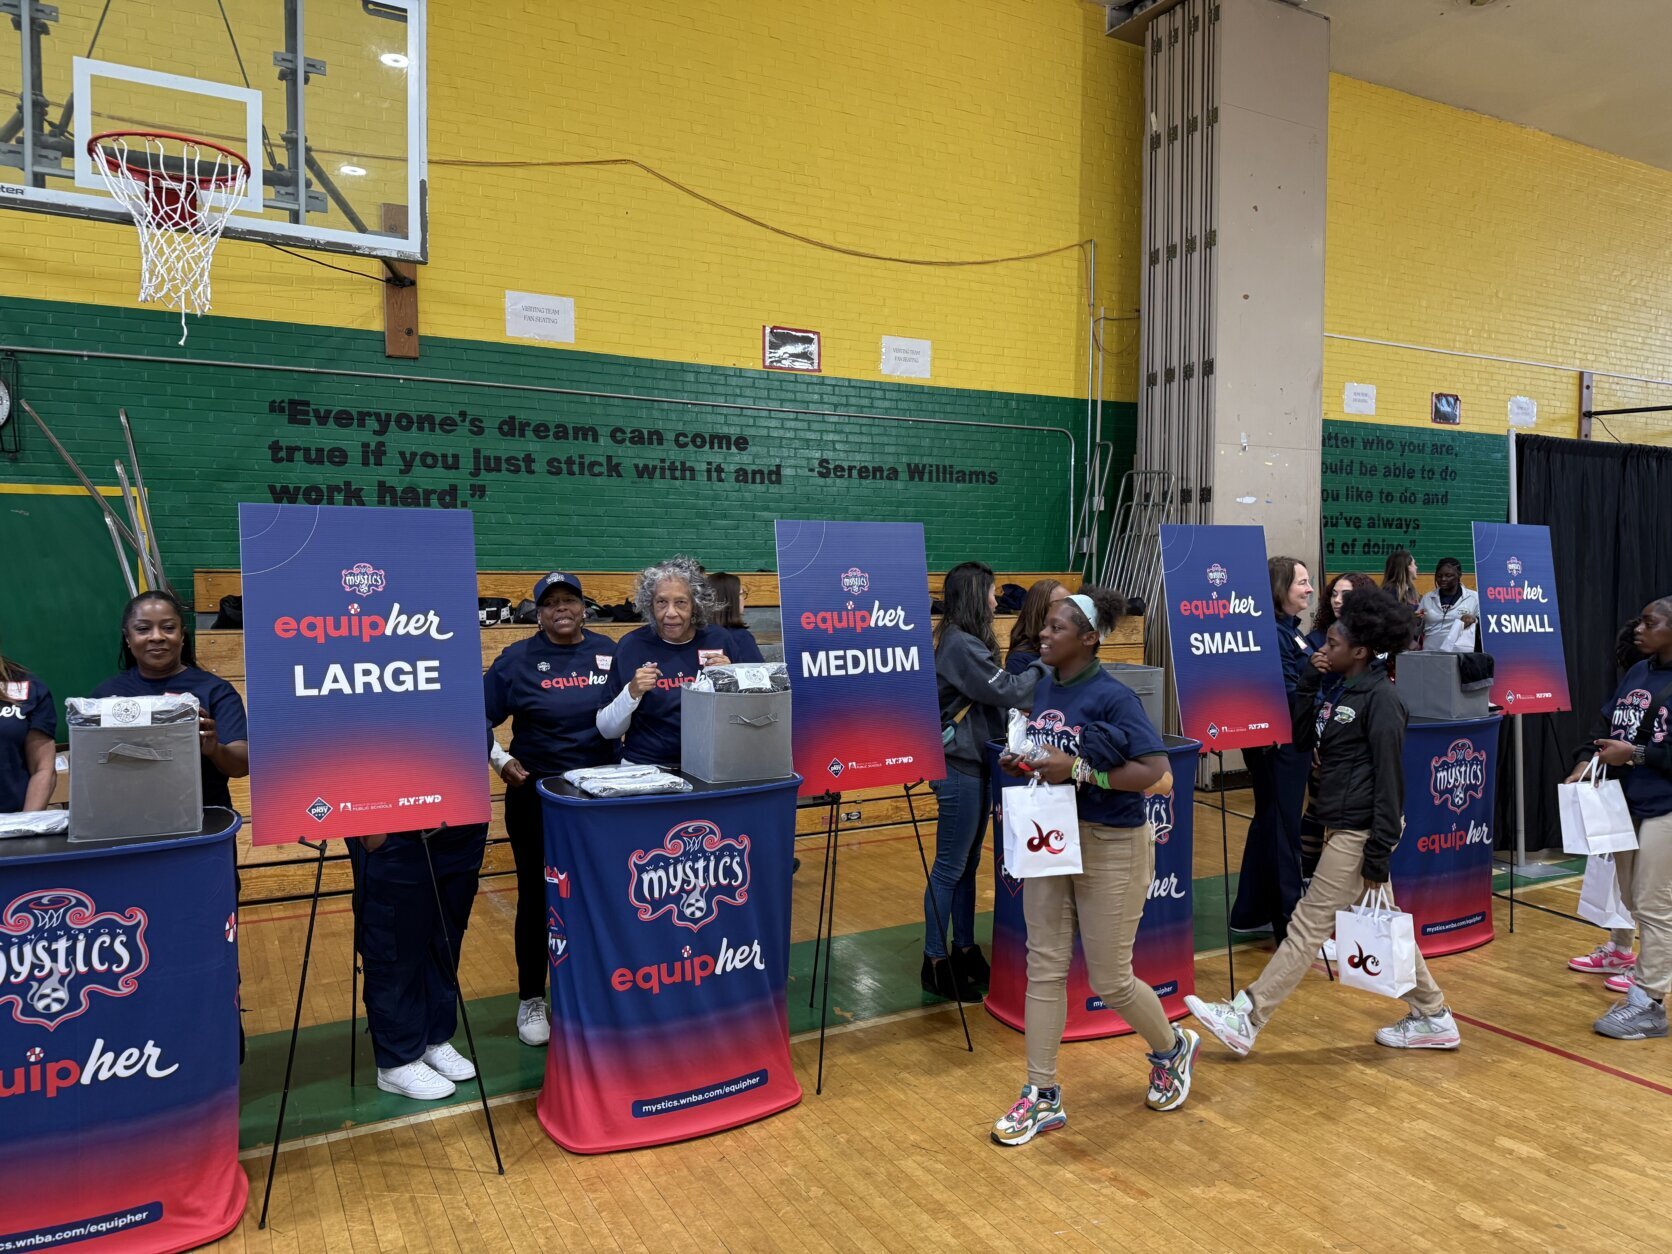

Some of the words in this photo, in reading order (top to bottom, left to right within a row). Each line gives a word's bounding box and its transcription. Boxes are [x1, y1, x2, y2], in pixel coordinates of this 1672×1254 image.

[498, 415, 599, 443] dream
[609, 426, 664, 446] can
[674, 431, 749, 451] come
[1362, 436, 1394, 451] who
[1400, 440, 1425, 457] you
[1431, 442, 1458, 458] are,
[268, 439, 348, 467] true
[361, 441, 387, 467] if
[398, 449, 460, 475] you
[469, 448, 536, 478] just
[546, 454, 624, 478] stick
[633, 458, 696, 481] with
[705, 461, 725, 482] it
[734, 463, 782, 485] and
[808, 458, 899, 481] -Serena
[906, 462, 999, 485] Williams
[1360, 460, 1378, 477] be
[1383, 461, 1416, 479] able
[1421, 465, 1435, 480] to
[1440, 466, 1457, 482] do
[267, 480, 369, 506] work
[376, 480, 487, 509] hard.”
[1345, 486, 1373, 503] like
[1380, 488, 1394, 504] to
[1399, 488, 1417, 504] do
[1423, 491, 1449, 506] and
[1367, 513, 1420, 534] always
[1341, 538, 1357, 554] of
[1180, 590, 1262, 619] equipher
[1487, 580, 1548, 603] equipher
[274, 602, 454, 644] equipher
[801, 600, 914, 633] equipher
[1487, 614, 1499, 633] X
[1500, 614, 1554, 633] SMALL
[1190, 630, 1261, 656] SMALL
[801, 646, 920, 678] MEDIUM
[294, 660, 441, 697] LARGE
[541, 670, 609, 689] equiphe
[1417, 820, 1492, 854] equipher
[640, 855, 743, 901] mystics
[0, 933, 131, 986] ystics
[611, 937, 766, 995] equipher
[642, 1076, 760, 1113] mystics.wnba.com/equipher
